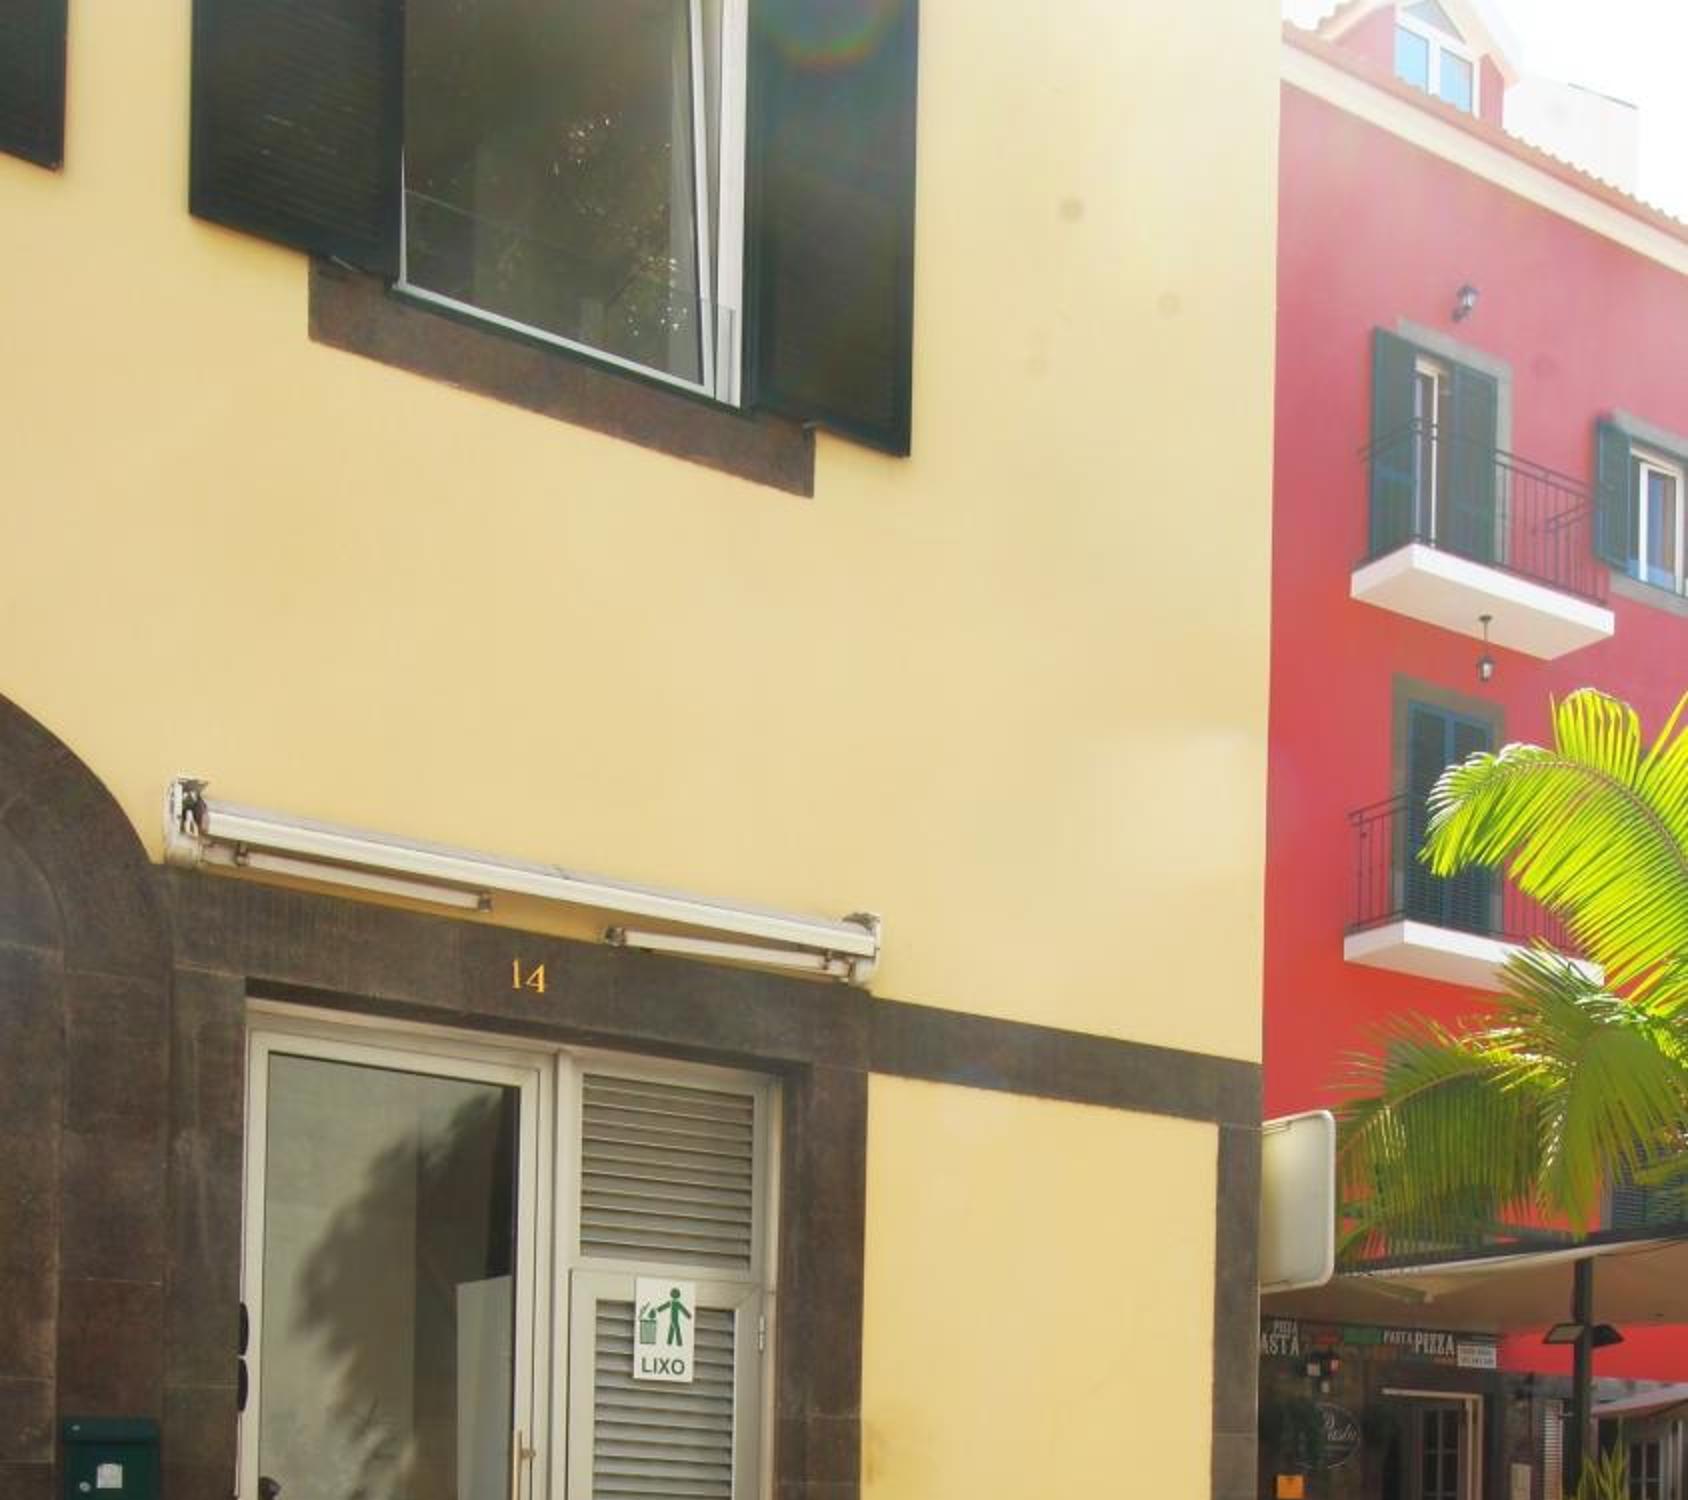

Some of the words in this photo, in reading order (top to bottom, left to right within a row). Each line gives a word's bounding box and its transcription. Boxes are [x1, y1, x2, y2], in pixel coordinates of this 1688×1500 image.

[512, 959, 545, 993] 14
[1414, 1331, 1456, 1356] PIZZA
[641, 1357, 686, 1375] LIXO
